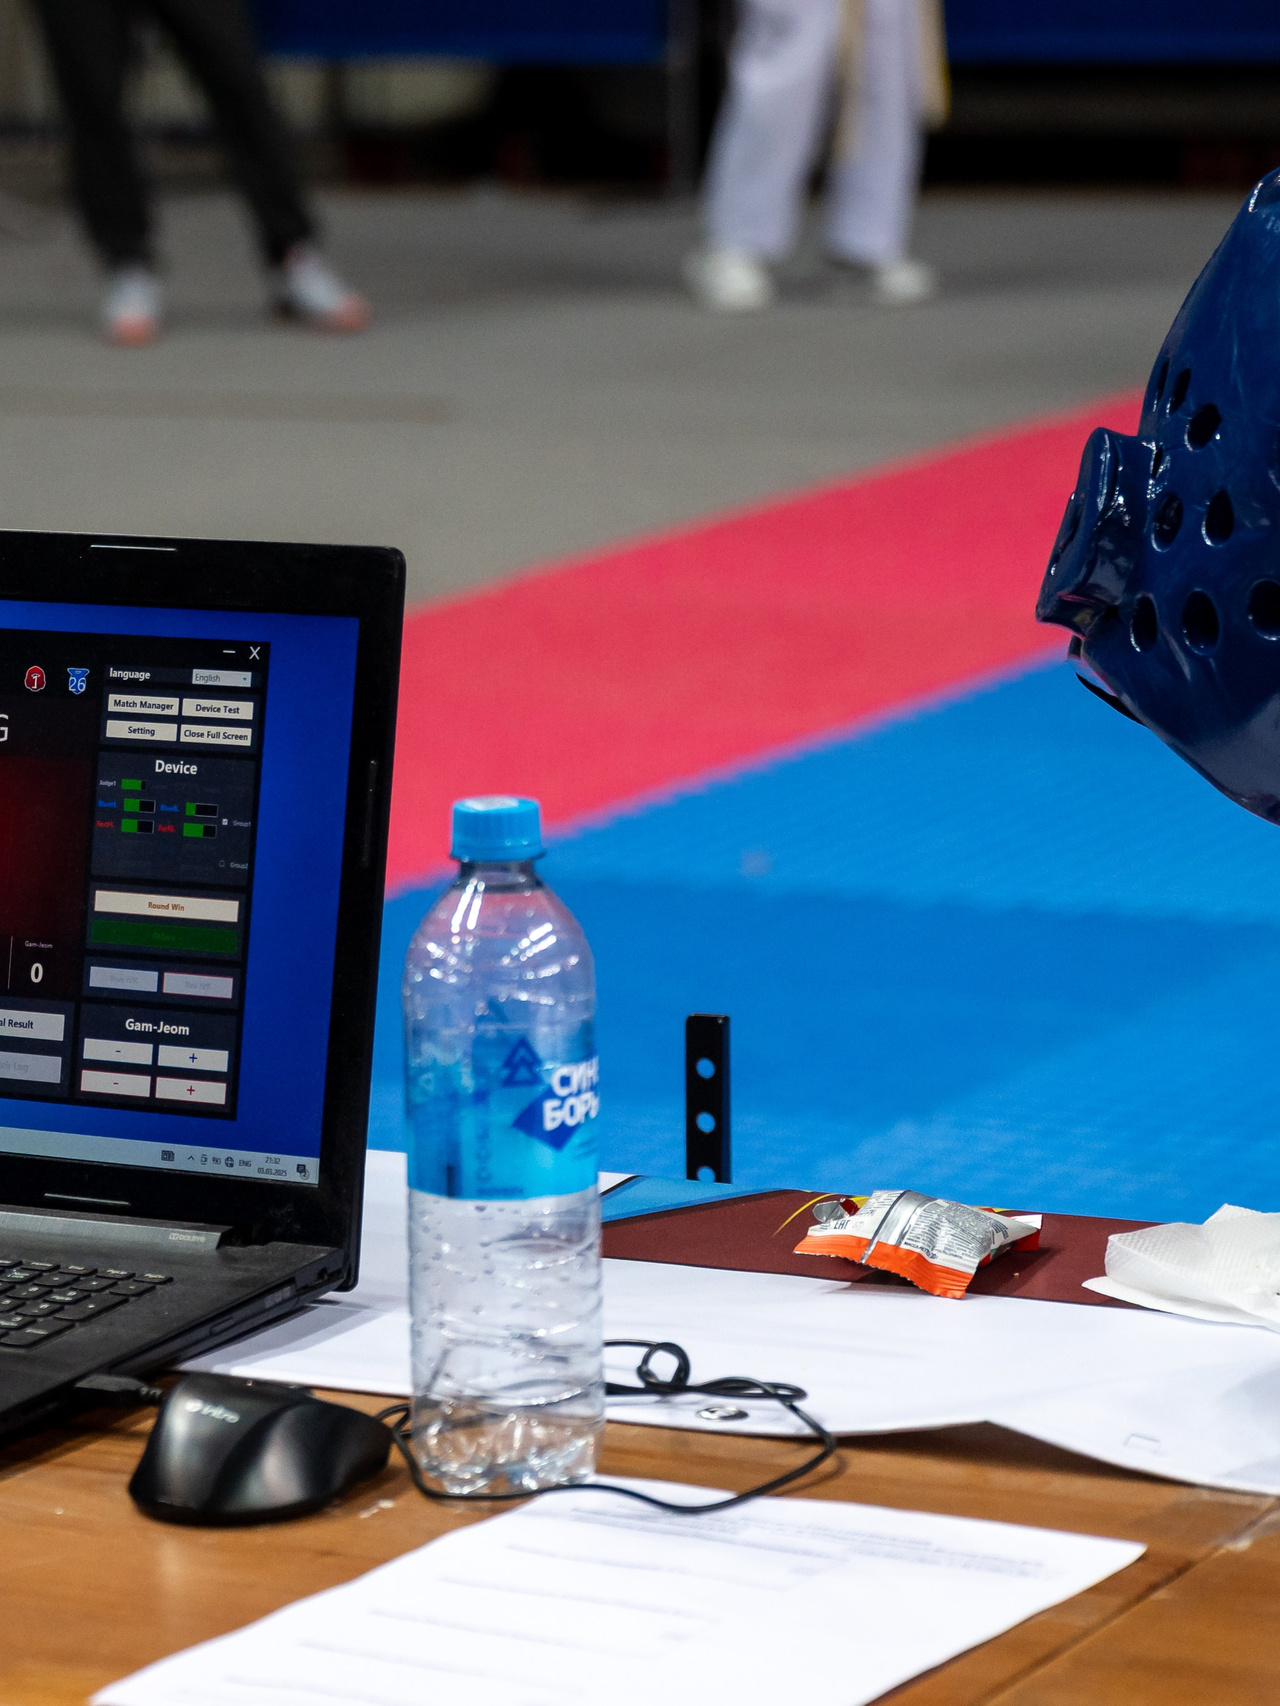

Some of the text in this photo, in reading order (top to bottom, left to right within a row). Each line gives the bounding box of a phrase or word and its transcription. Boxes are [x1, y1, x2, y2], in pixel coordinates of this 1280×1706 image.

[109, 668, 150, 681] language
[194, 672, 221, 684] English
[68, 677, 86, 693] 26
[113, 698, 174, 713] Match Manager
[195, 703, 240, 715] Device Test
[127, 725, 155, 738] Setting
[183, 729, 249, 742] Close Full Screen
[155, 759, 198, 775] Device
[147, 901, 185, 912] Round Win
[30, 962, 44, 984] 0
[9, 1017, 34, 1030] Result
[125, 1017, 190, 1036] Gam-Jeom
[265, 1156, 281, 1164] 21:32
[257, 1167, 287, 1177] 03.03.2025
